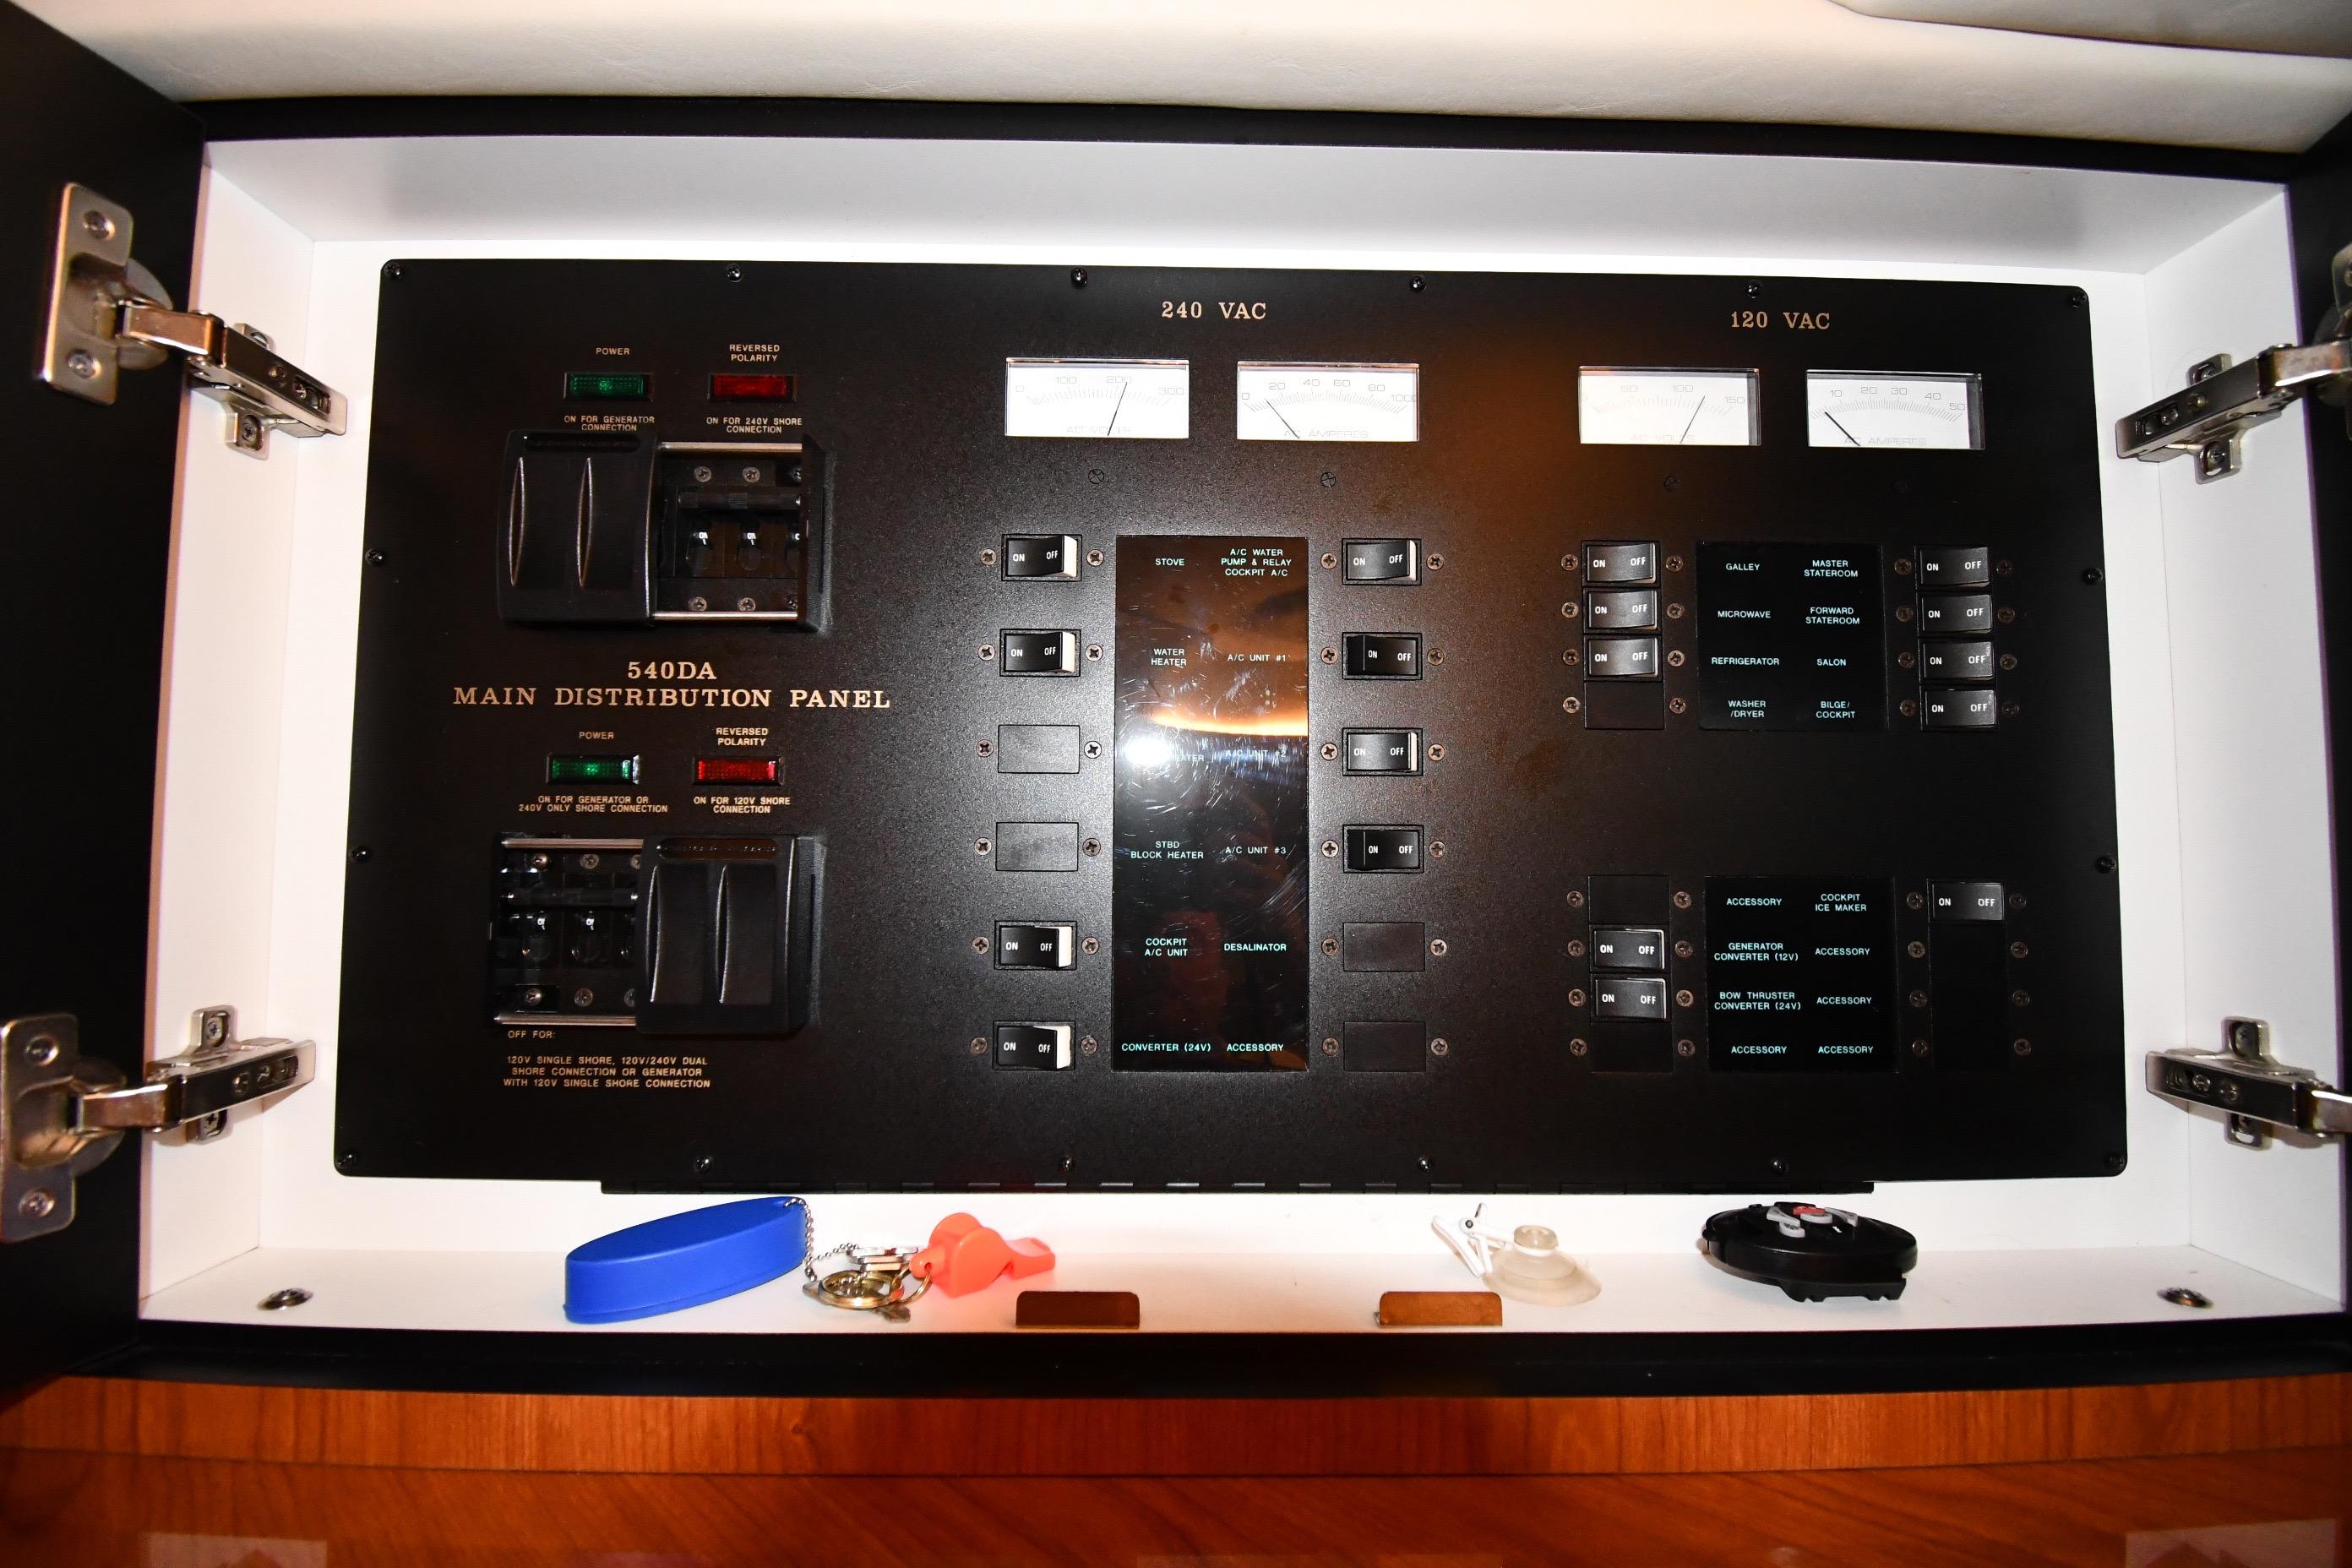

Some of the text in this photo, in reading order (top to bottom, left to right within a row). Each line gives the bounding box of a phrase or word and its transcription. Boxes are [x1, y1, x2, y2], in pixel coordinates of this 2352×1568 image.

[1162, 301, 1266, 320] 240 VAC
[1731, 310, 1830, 330] 120 VAC
[596, 347, 630, 356] POWER
[729, 344, 780, 352] REVERSED
[731, 353, 778, 362] POLARITY
[1268, 381, 1287, 391] 20
[1302, 378, 1320, 388] 40
[1333, 378, 1352, 388] 60
[1829, 389, 1843, 399] 10
[1859, 386, 1878, 395] 20
[1890, 386, 1908, 395] 30
[1924, 391, 1942, 401] 40
[1948, 402, 1966, 411] 50
[564, 415, 655, 424] ON FOR GENERATOR
[705, 416, 803, 426] ON FOR 240V SHORE
[581, 423, 637, 432] CONNECTION
[726, 425, 782, 433] CONNECTION
[1867, 436, 1927, 446] AMPERES
[1046, 549, 1059, 560] OFF
[1229, 547, 1283, 557] A/C WATER
[1012, 553, 1026, 562] ON
[1155, 558, 1185, 566] STOVE
[1353, 557, 1366, 566] ON
[1389, 553, 1403, 564] OFF
[1630, 556, 1646, 567] OFF
[1221, 558, 1292, 567] PUMP & RELAY
[1592, 559, 1606, 568] ON
[1725, 563, 1761, 571] GALLEY
[1812, 559, 1848, 568] MASTER
[1926, 563, 1939, 571] ON
[1964, 560, 1982, 570] OFF
[1224, 568, 1288, 577] COCKPIT A/C
[1804, 569, 1859, 578] STATEROOM
[1594, 606, 1608, 614] ON
[1631, 603, 1647, 613] OFF
[1810, 607, 1854, 615] FORWARD
[1966, 607, 1984, 618] OFF
[1717, 610, 1772, 618] MICROWAVE
[1928, 610, 1941, 618] ON
[1805, 616, 1860, 625] STATEROOM
[1010, 648, 1023, 657] ON
[1043, 646, 1057, 656] OFF
[1153, 648, 1185, 656] WATER
[1368, 650, 1378, 659] ON
[1227, 653, 1244, 662] A/C
[1275, 654, 1287, 662] #1
[1397, 652, 1412, 662] OFF
[1594, 653, 1608, 662] ON
[1631, 651, 1648, 662] OFF
[1711, 656, 1780, 666] REFRIGERATOR
[1930, 656, 1942, 665] ON
[1968, 654, 1986, 665] OFF
[1150, 657, 1188, 667] HEATER
[1816, 658, 1847, 667] SALON
[628, 661, 717, 680] 540DA
[453, 687, 890, 709] MAIN DISTRIBUTION PANEL
[1728, 700, 1767, 708] WASHER
[1820, 700, 1850, 709] BILGE/
[1931, 704, 1944, 713] ON
[1970, 703, 1988, 712] OFF
[1730, 710, 1765, 718] /DRYER
[1816, 710, 1856, 719] COCKPIT
[579, 731, 614, 740] POWER
[716, 727, 769, 736] REVERSED
[717, 738, 767, 746] POLARITY
[1353, 747, 1366, 757] ON
[1390, 747, 1404, 756] OFF
[537, 795, 649, 804] ON FOR GENERATOR OR
[693, 796, 791, 805] ON FOR 120V SHORE
[518, 803, 668, 813] 240V ONLY SHORE CONNECTION
[713, 804, 770, 814] CONNECTION
[1155, 841, 1180, 849] STBD
[1368, 845, 1379, 854] ON
[1398, 845, 1413, 854] OFF
[1225, 846, 1243, 854] A/C
[1247, 846, 1269, 854] UNIT
[1130, 851, 1204, 859] BLOCK HEATER
[1726, 897, 1783, 906] ACCESSORY
[1821, 893, 1860, 901] COCKPIT
[1938, 897, 1952, 906] ON
[1978, 898, 1995, 907] OFF
[1815, 903, 1867, 912] ICE MAKER
[1005, 941, 1019, 950] ON
[1145, 937, 1188, 946] COCKPIT
[1728, 942, 1783, 950] GENERATOR
[1040, 942, 1053, 952] OFF
[1223, 943, 1287, 952] DESALINATOR
[1599, 944, 1614, 954] ON
[1638, 945, 1655, 955] OFF
[1815, 947, 1870, 956] ACCESSORY
[1144, 948, 1189, 957] A/C UNIT
[1713, 952, 1799, 961] CONVERTER (12V)
[1601, 994, 1615, 1003] ON
[1640, 994, 1657, 1004] OFF
[1719, 991, 1795, 1000] BOW THRUSTER
[1816, 996, 1872, 1004] ACCESSORY
[1714, 1001, 1801, 1010] CONVERTER (24V)
[508, 1030, 556, 1040] OFF FOR:
[1003, 1042, 1016, 1051] ON
[1037, 1043, 1051, 1054] OFF
[1121, 1043, 1211, 1053] CONVERTER (24V)
[1226, 1043, 1284, 1052] ACCESSORY
[1730, 1045, 1788, 1054] ACCESSORY
[1817, 1045, 1874, 1054] ACCESSORY
[507, 1055, 708, 1066] 120V SINGLE SHORE, 120V/240V DUAL
[512, 1067, 702, 1077] SHORE CONNECTION OR GENERATOR
[503, 1078, 710, 1088] WITH 120V SINGLE SHORE CONNECTION
